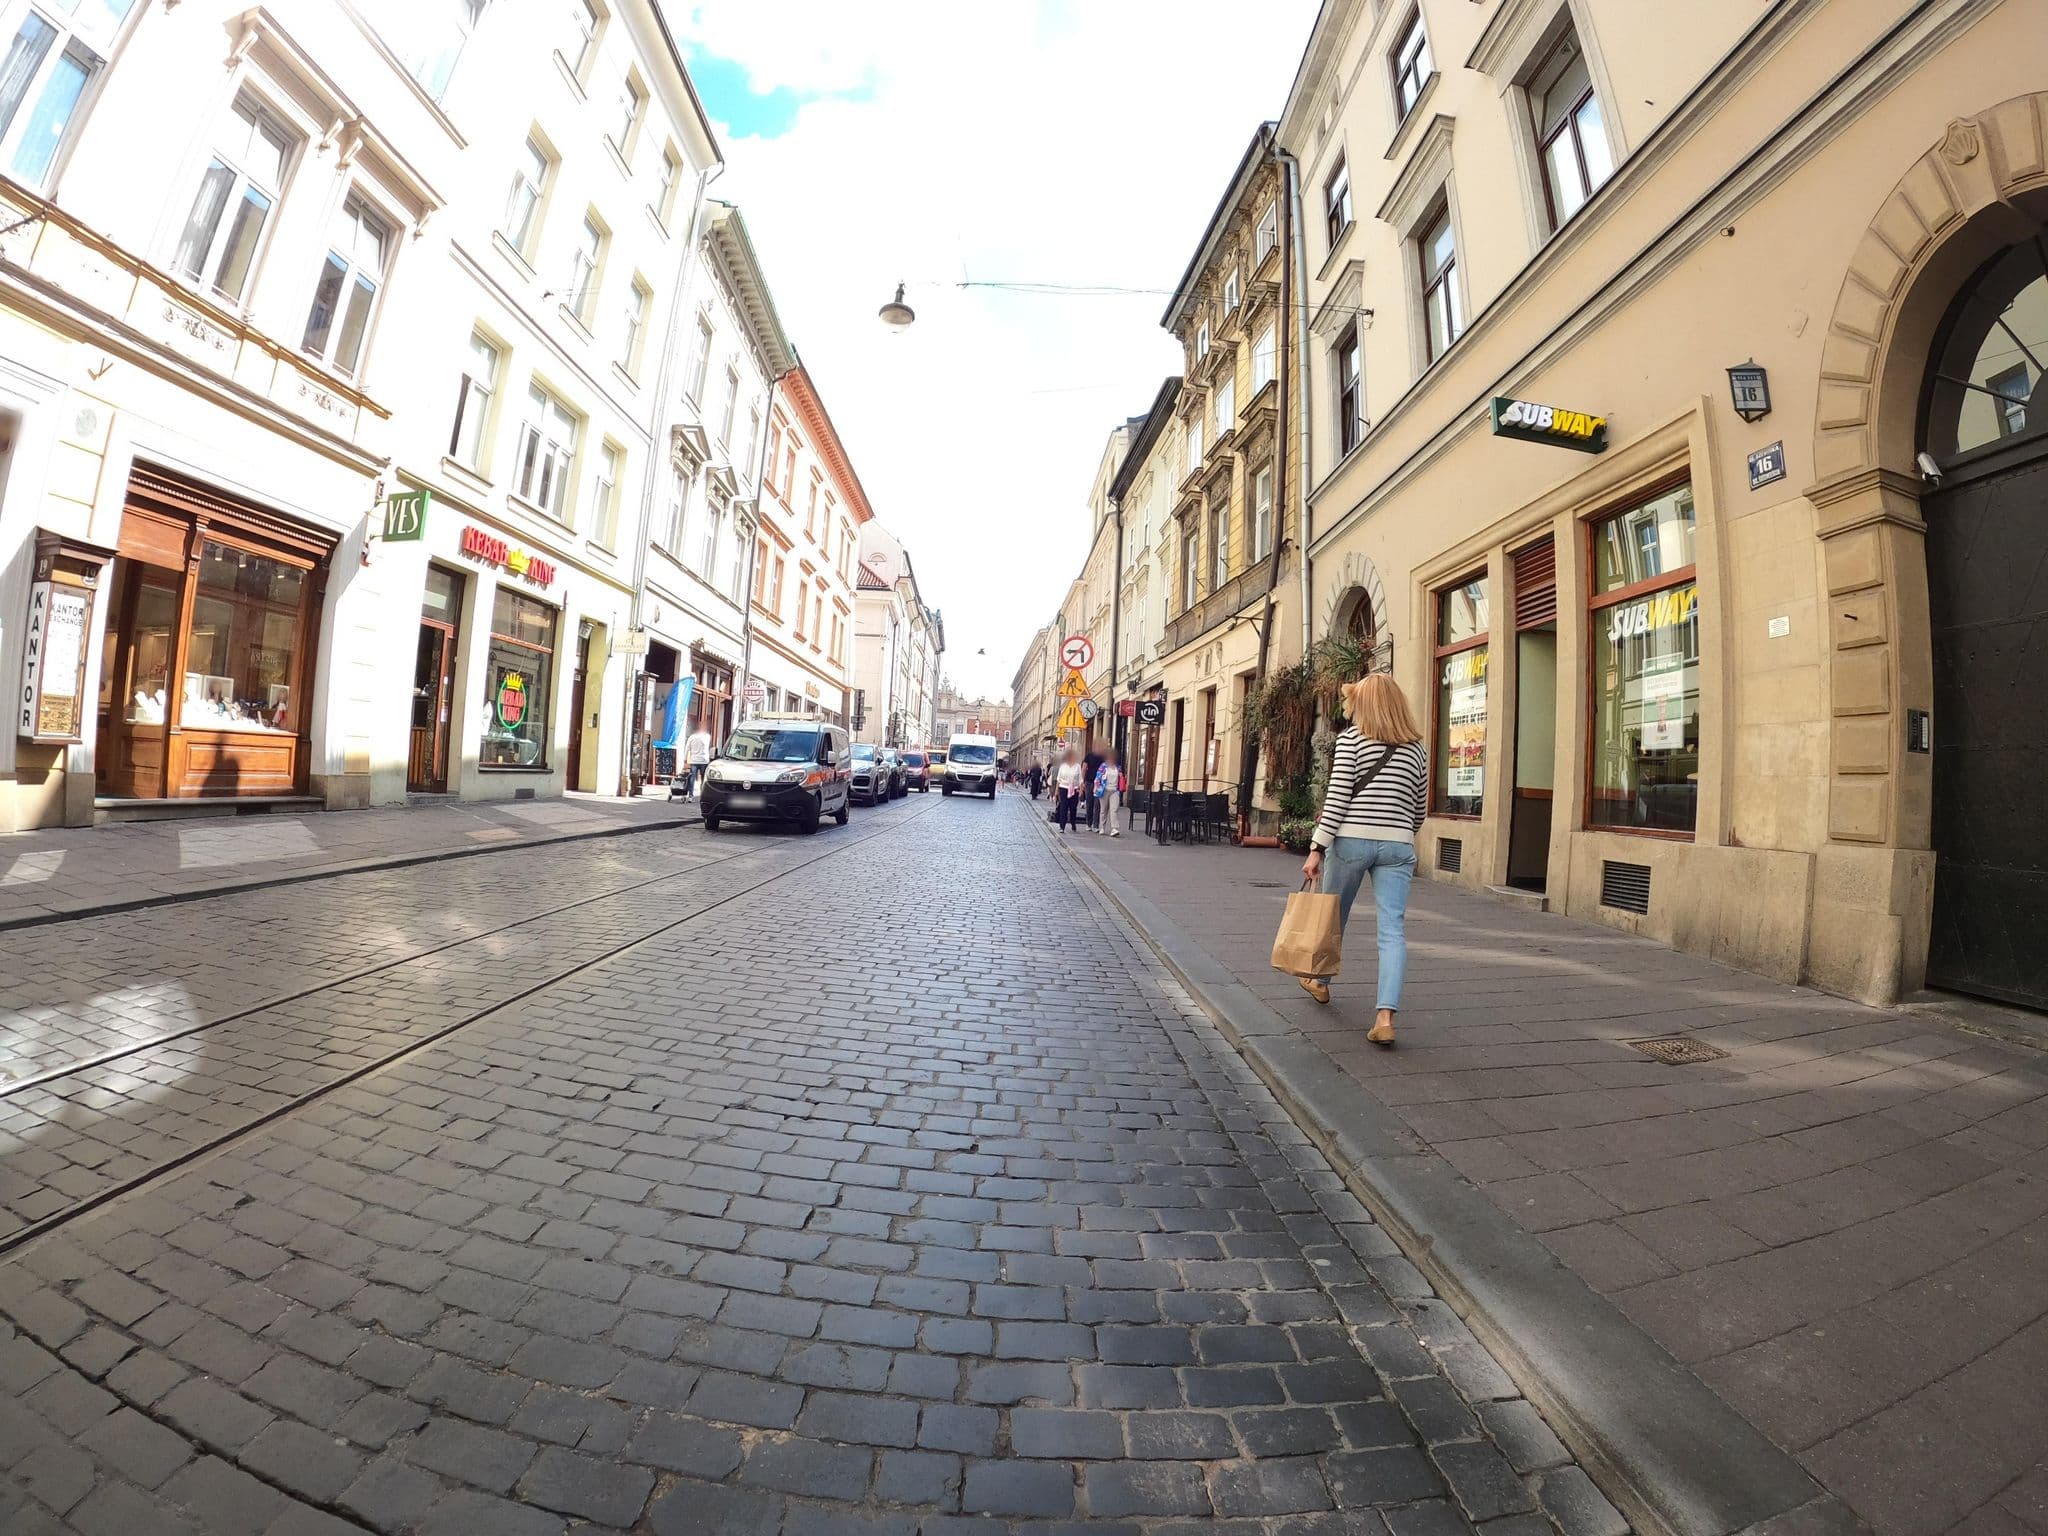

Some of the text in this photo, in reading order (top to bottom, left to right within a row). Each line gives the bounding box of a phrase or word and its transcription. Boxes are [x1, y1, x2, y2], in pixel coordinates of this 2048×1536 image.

[1741, 387, 1757, 402] 16
[1499, 401, 1607, 437] SUBWAY
[1757, 455, 1773, 474] 16
[464, 526, 556, 585] KEBAB KING
[1608, 584, 1698, 641] SUBWAY
[22, 591, 44, 727] KANTOR
